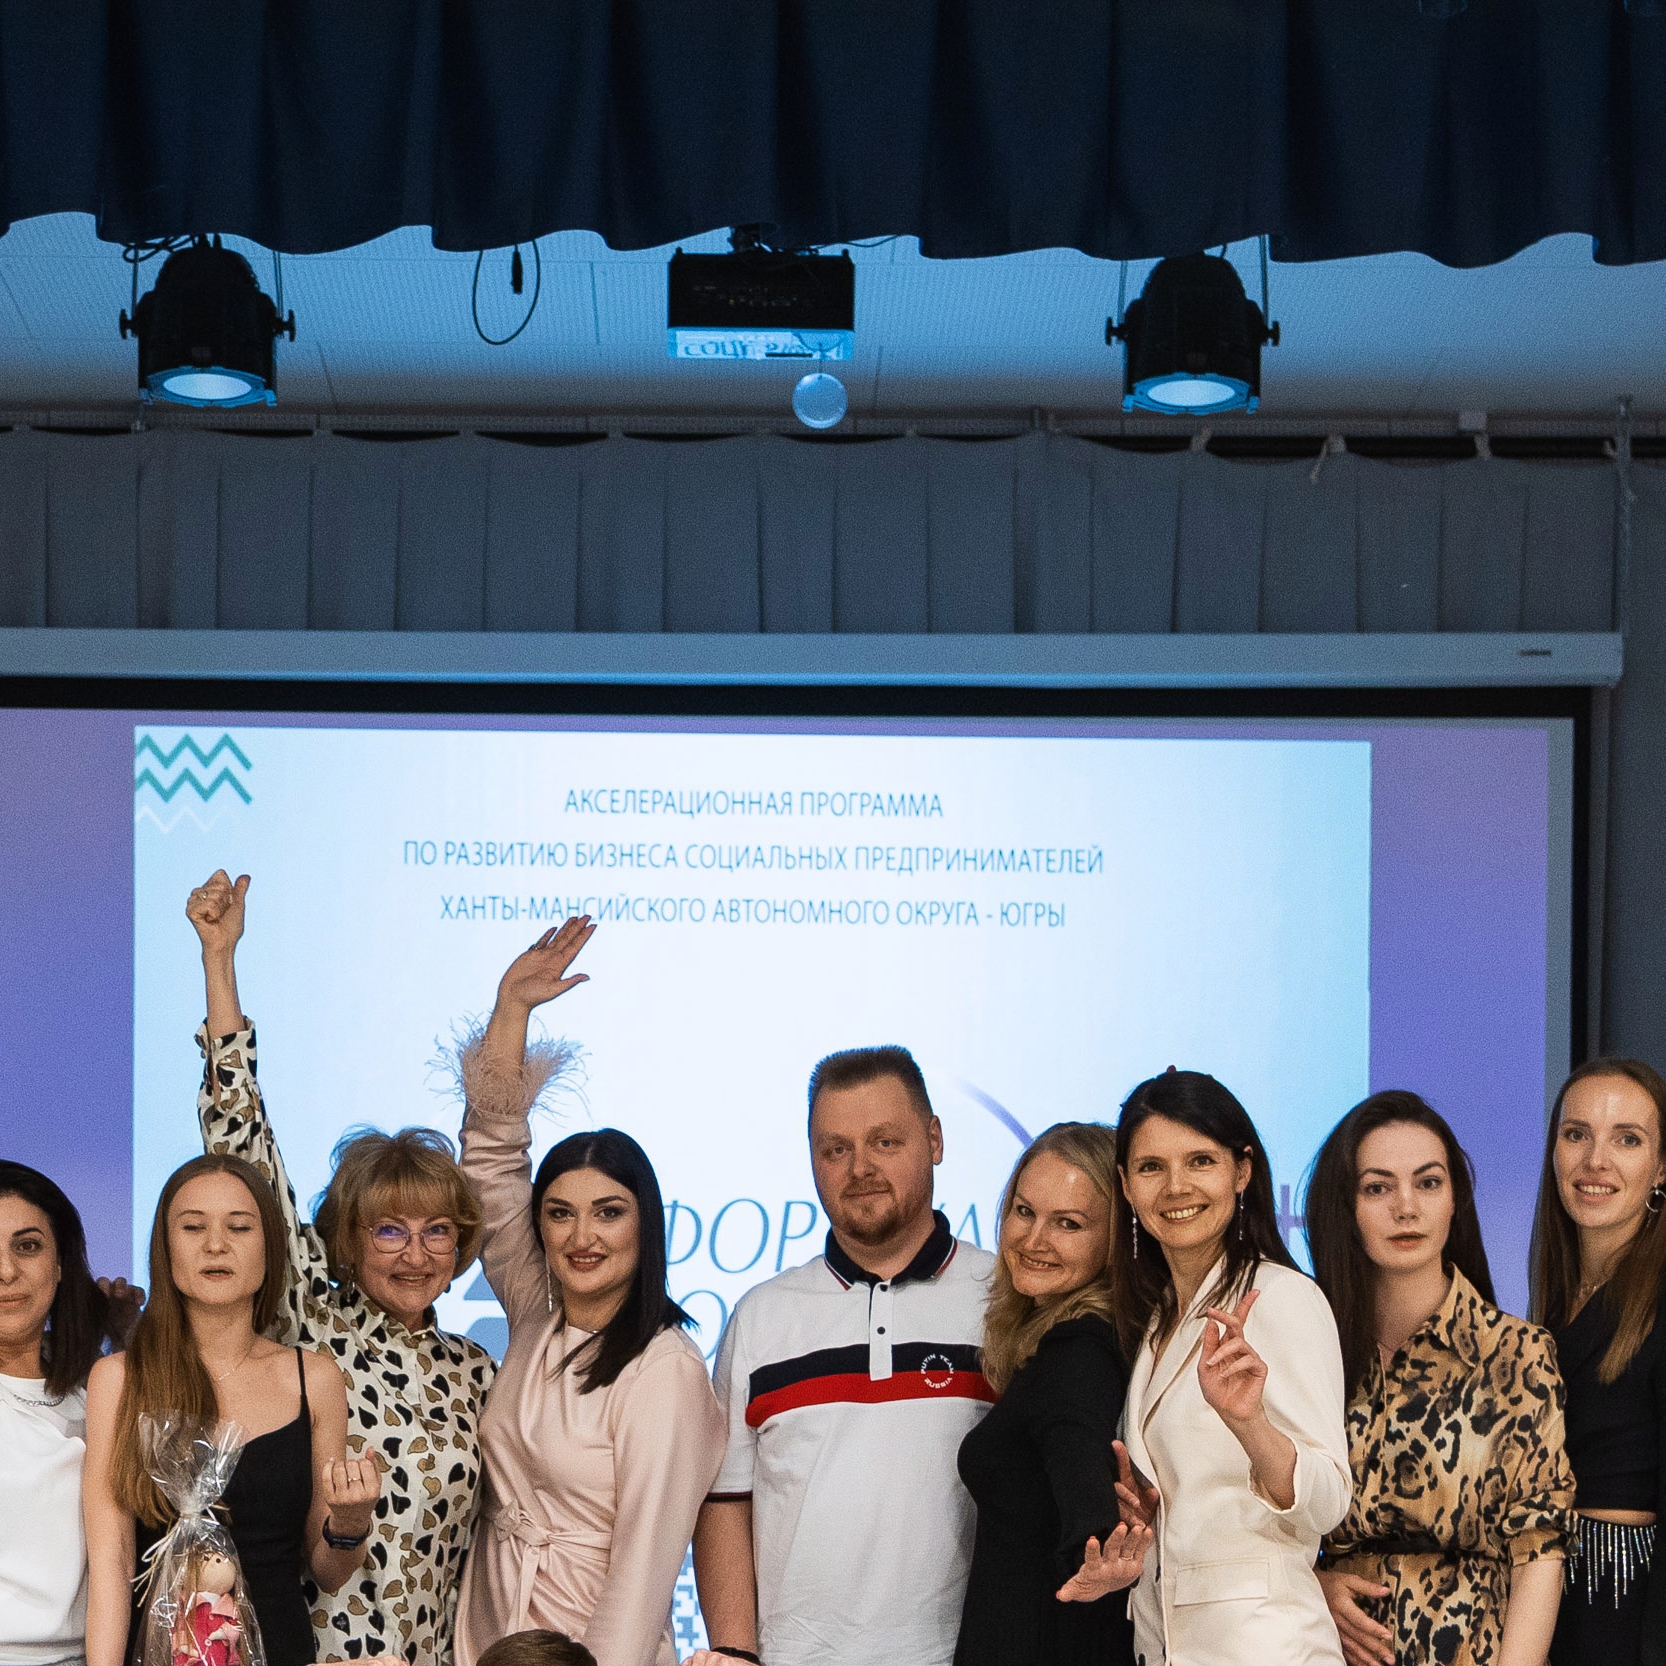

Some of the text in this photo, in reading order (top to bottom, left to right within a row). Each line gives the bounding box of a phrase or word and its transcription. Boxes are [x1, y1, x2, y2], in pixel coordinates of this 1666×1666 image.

[564, 789, 944, 819] АКСЕЛЕРАЦИОННАЯ ПРОГРАММА
[404, 840, 1104, 876] ПО РАЗВИТИЮ БИЗНЕСА СОЦИАЛЬНЫХ ПРЕДПРИНИМАТЕЛЕЙ
[440, 893, 706, 923] ХАНТЫ-МАНСИЙСКОГО
[712, 898, 890, 924] АВТОНОМНОГО
[896, 901, 980, 926] ОКРУГА
[1000, 902, 1066, 927] ЮГРЫ
[920, 1353, 955, 1375] PUTIN TEAM
[924, 1377, 953, 1389] RUSSIA
